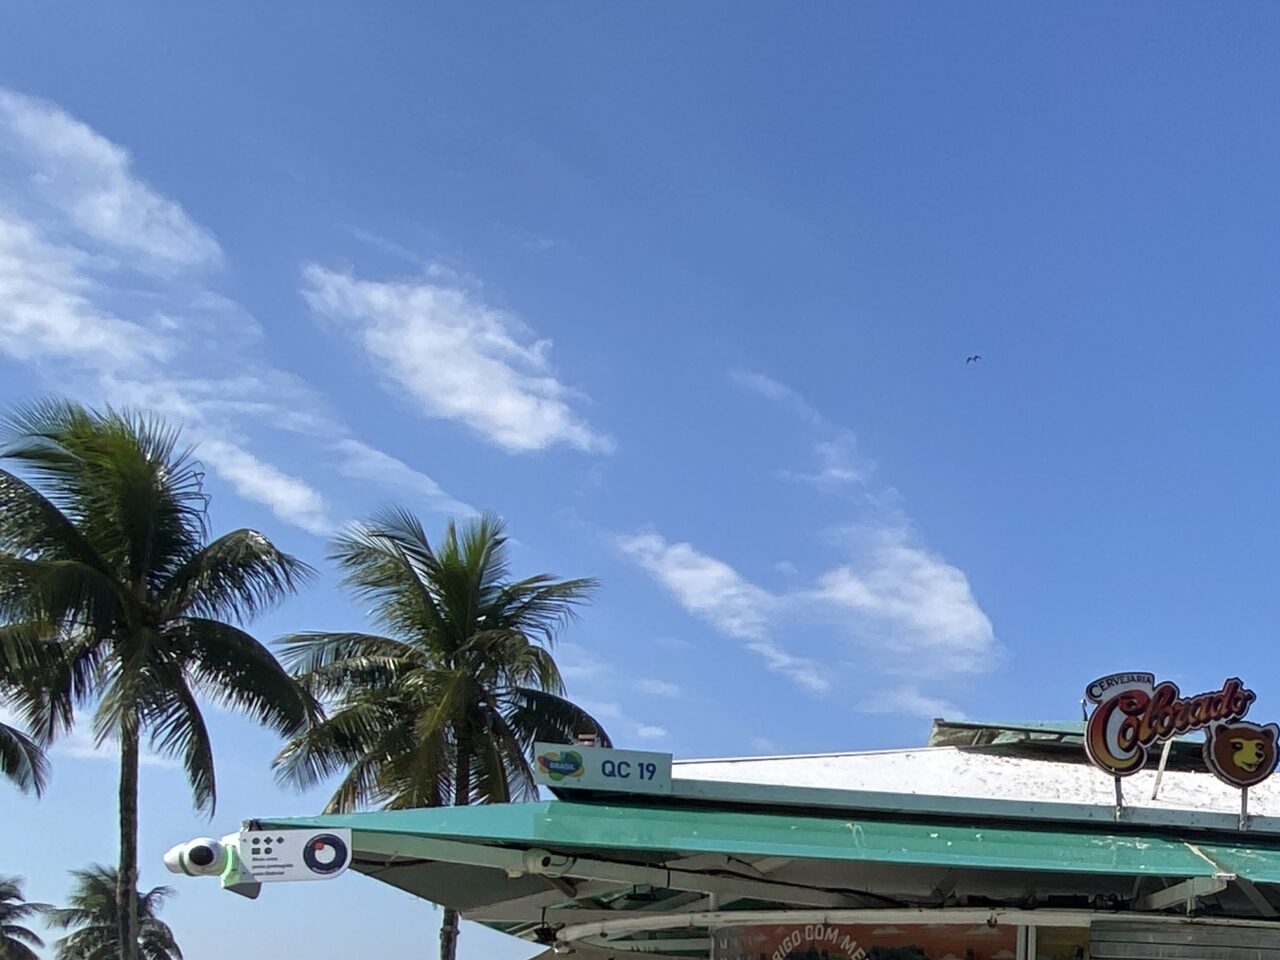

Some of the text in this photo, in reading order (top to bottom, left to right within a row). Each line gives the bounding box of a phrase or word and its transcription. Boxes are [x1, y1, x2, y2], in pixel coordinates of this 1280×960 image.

[1090, 674, 1153, 699] CERVEJARIA
[1088, 677, 1256, 774] Colorado
[601, 760, 656, 780] QC 19
[805, 924, 839, 944] COM
